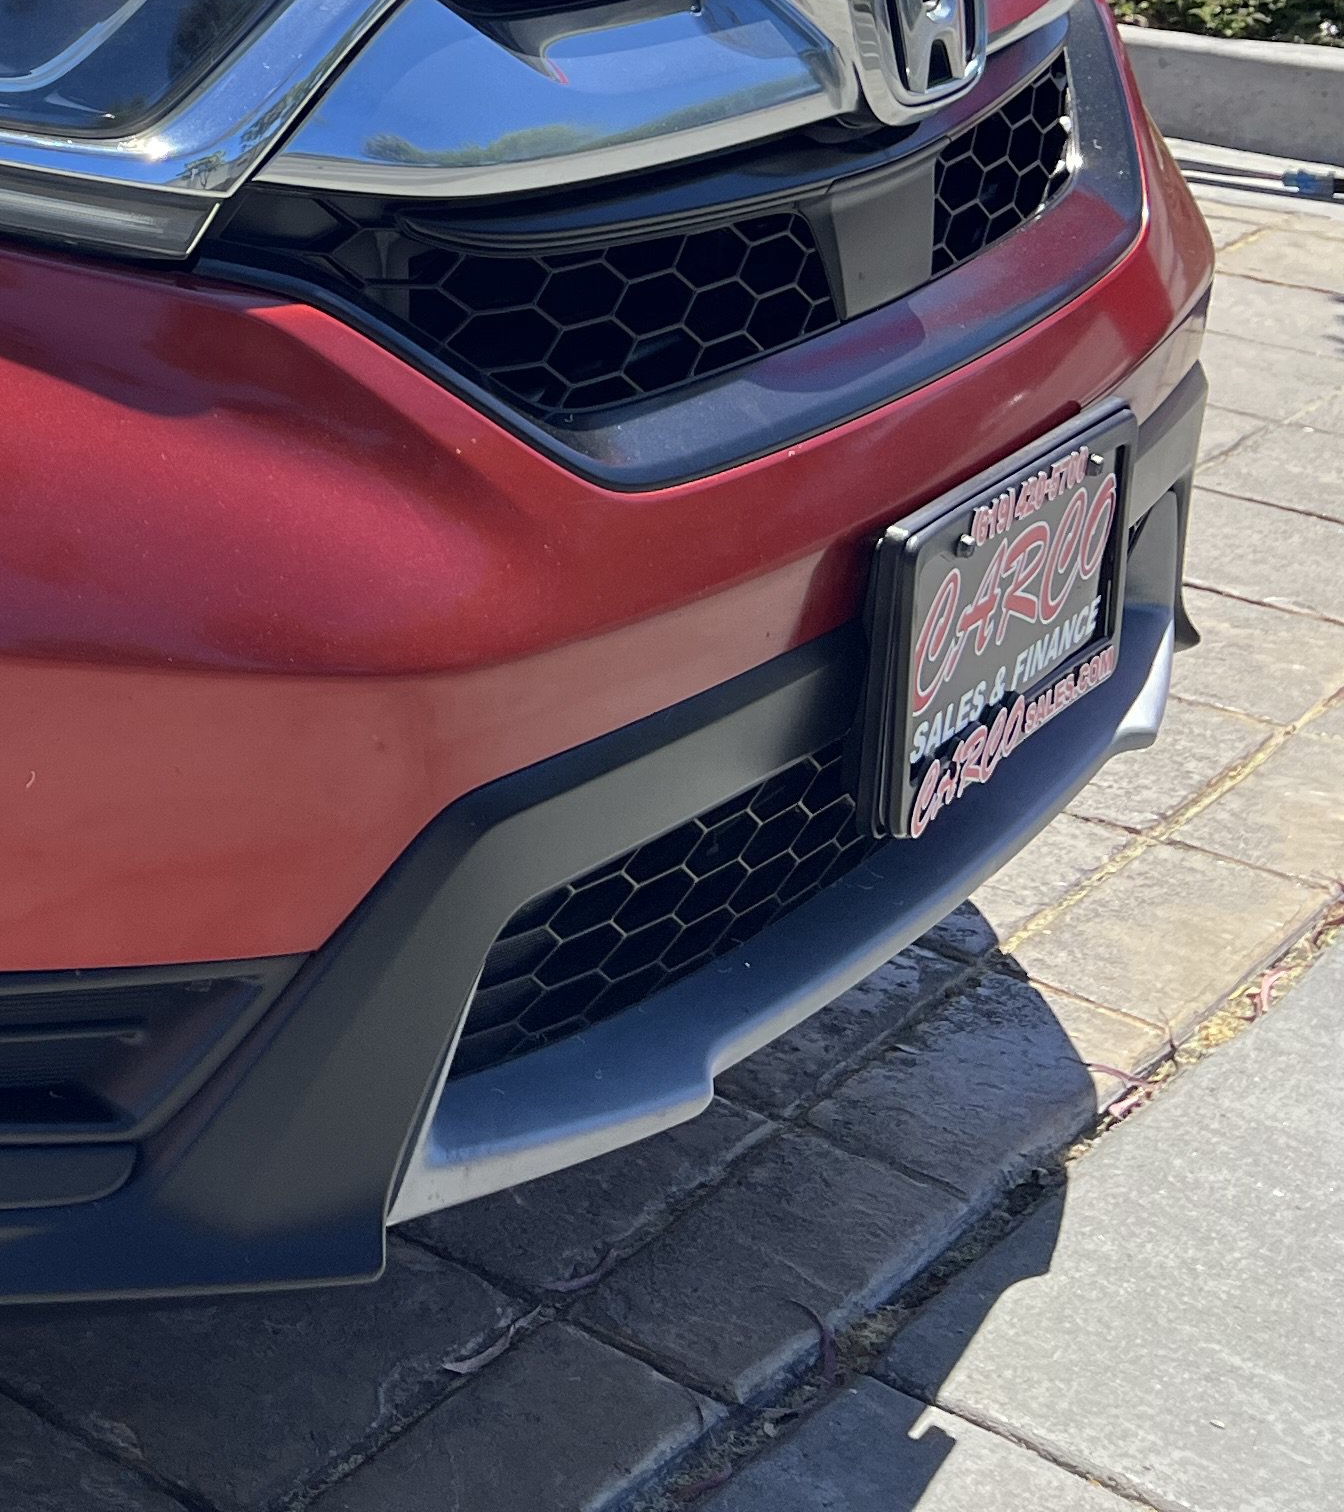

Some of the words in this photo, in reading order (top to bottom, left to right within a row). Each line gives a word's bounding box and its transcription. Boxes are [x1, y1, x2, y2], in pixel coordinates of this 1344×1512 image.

[971, 487, 1016, 546] (619)
[1004, 445, 1089, 521] 420-5700
[910, 680, 986, 764] SALES
[988, 665, 1006, 707] &
[1010, 594, 1102, 692] FINANCE
[912, 473, 1117, 716] CARCO
